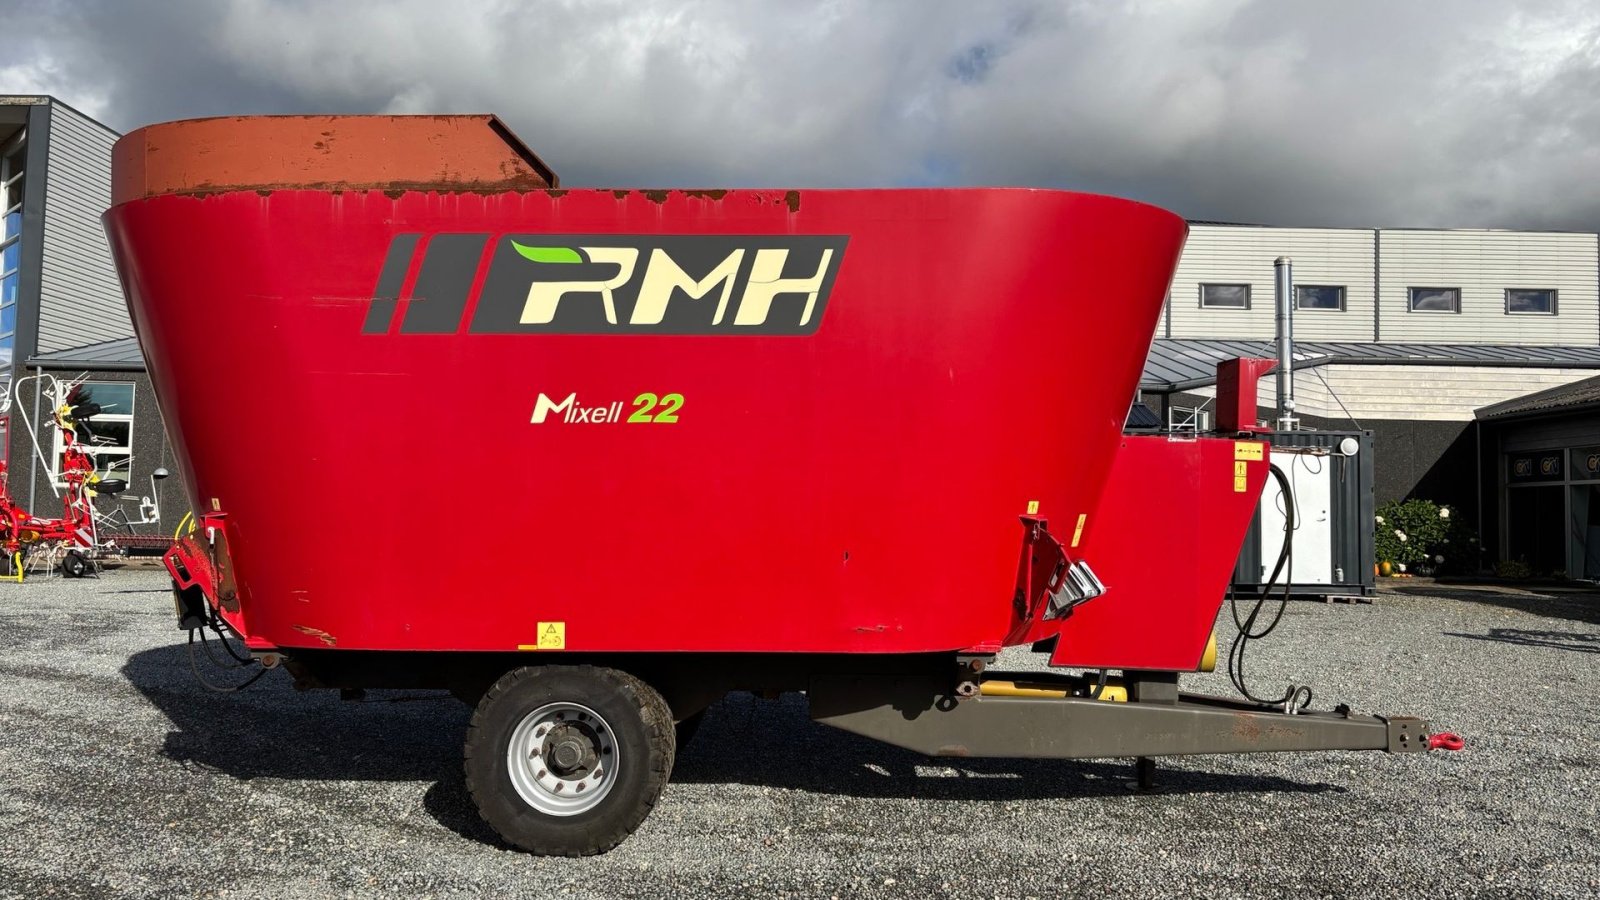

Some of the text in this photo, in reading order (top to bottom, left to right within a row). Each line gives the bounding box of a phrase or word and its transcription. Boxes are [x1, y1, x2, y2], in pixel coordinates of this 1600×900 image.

[514, 243, 834, 326] RMH
[530, 392, 685, 424] Mixell 22
